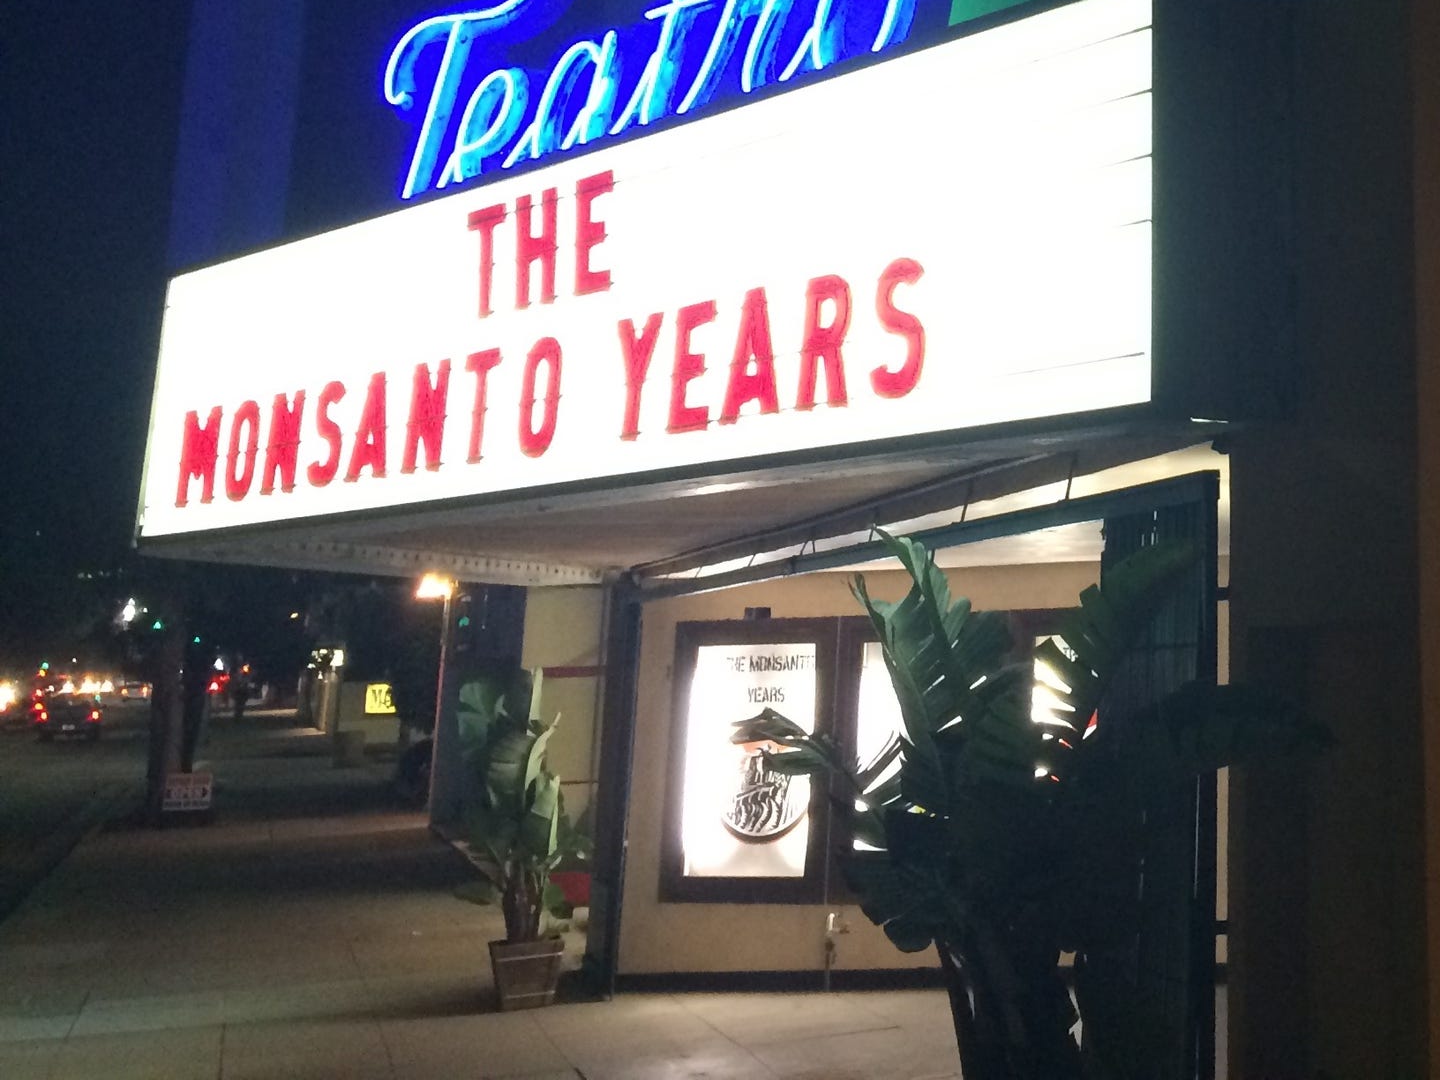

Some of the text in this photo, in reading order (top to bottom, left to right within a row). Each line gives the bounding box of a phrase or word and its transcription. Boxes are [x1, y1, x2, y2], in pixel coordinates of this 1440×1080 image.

[467, 168, 615, 319] THE
[174, 256, 926, 509] MONSANTO YEARS
[747, 686, 785, 703] YEARS
